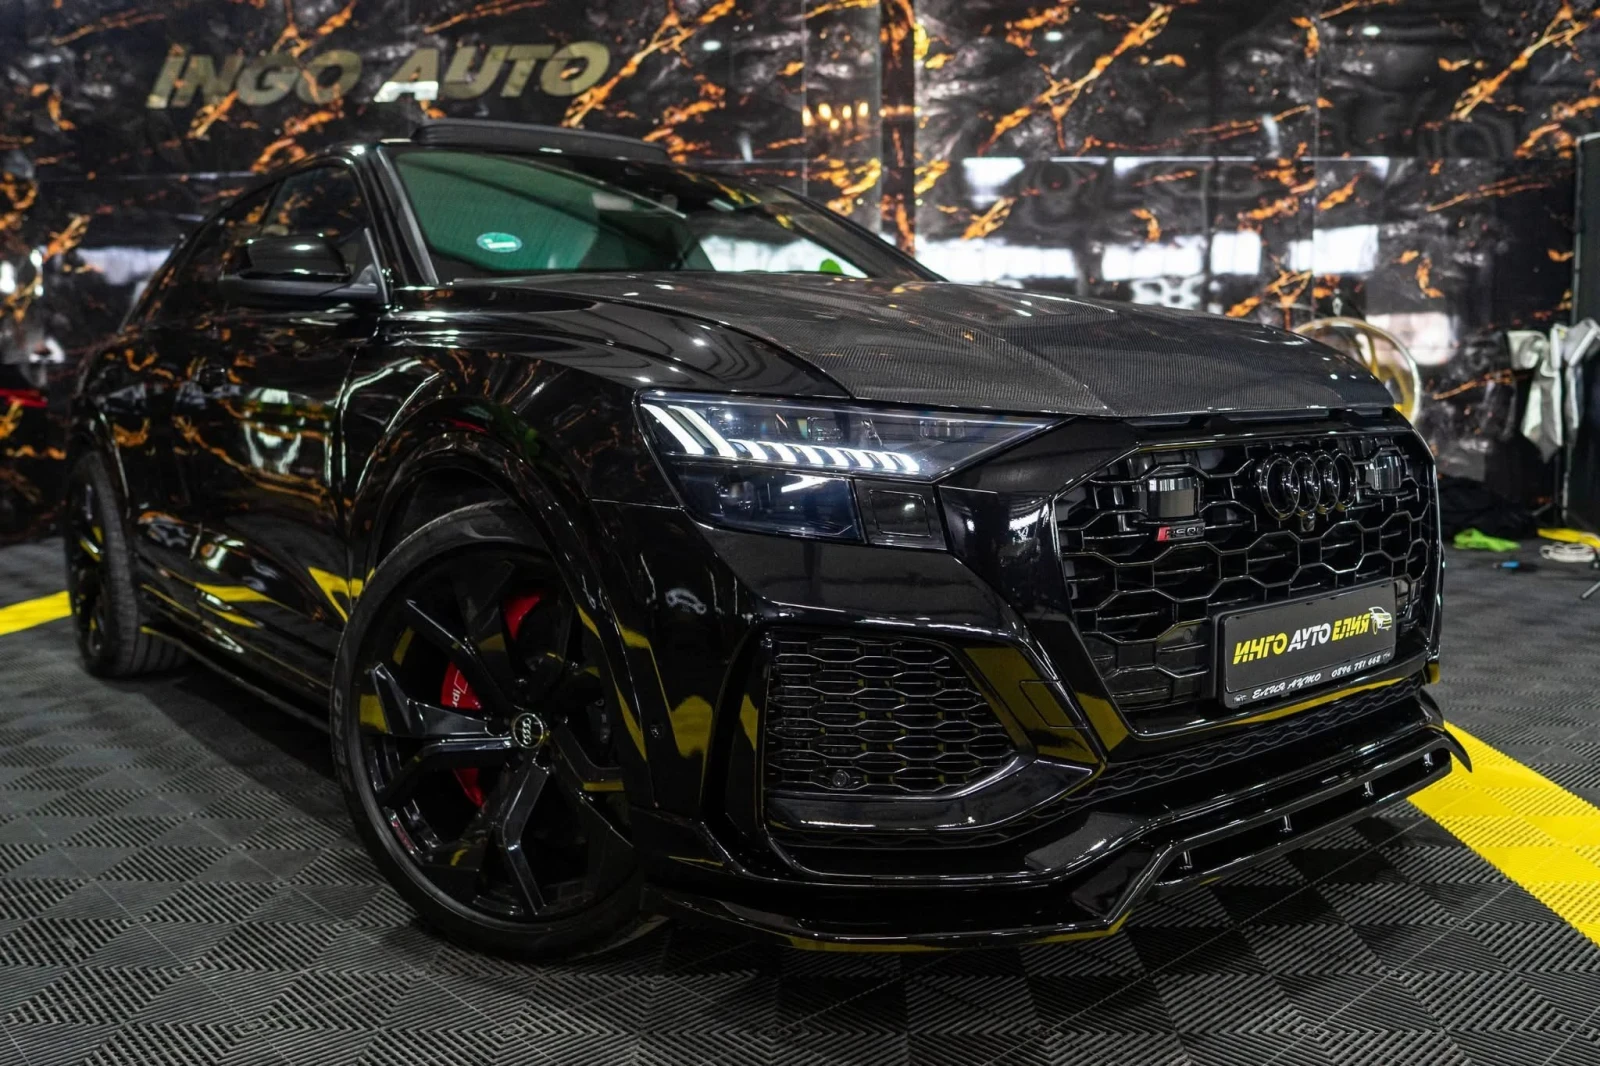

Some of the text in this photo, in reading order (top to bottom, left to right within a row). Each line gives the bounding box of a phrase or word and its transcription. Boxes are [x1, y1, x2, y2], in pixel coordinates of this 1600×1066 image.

[146, 42, 609, 108] INGO AUTO
[1232, 613, 1371, 665] ИНГО АУТО ЕЛИЯ
